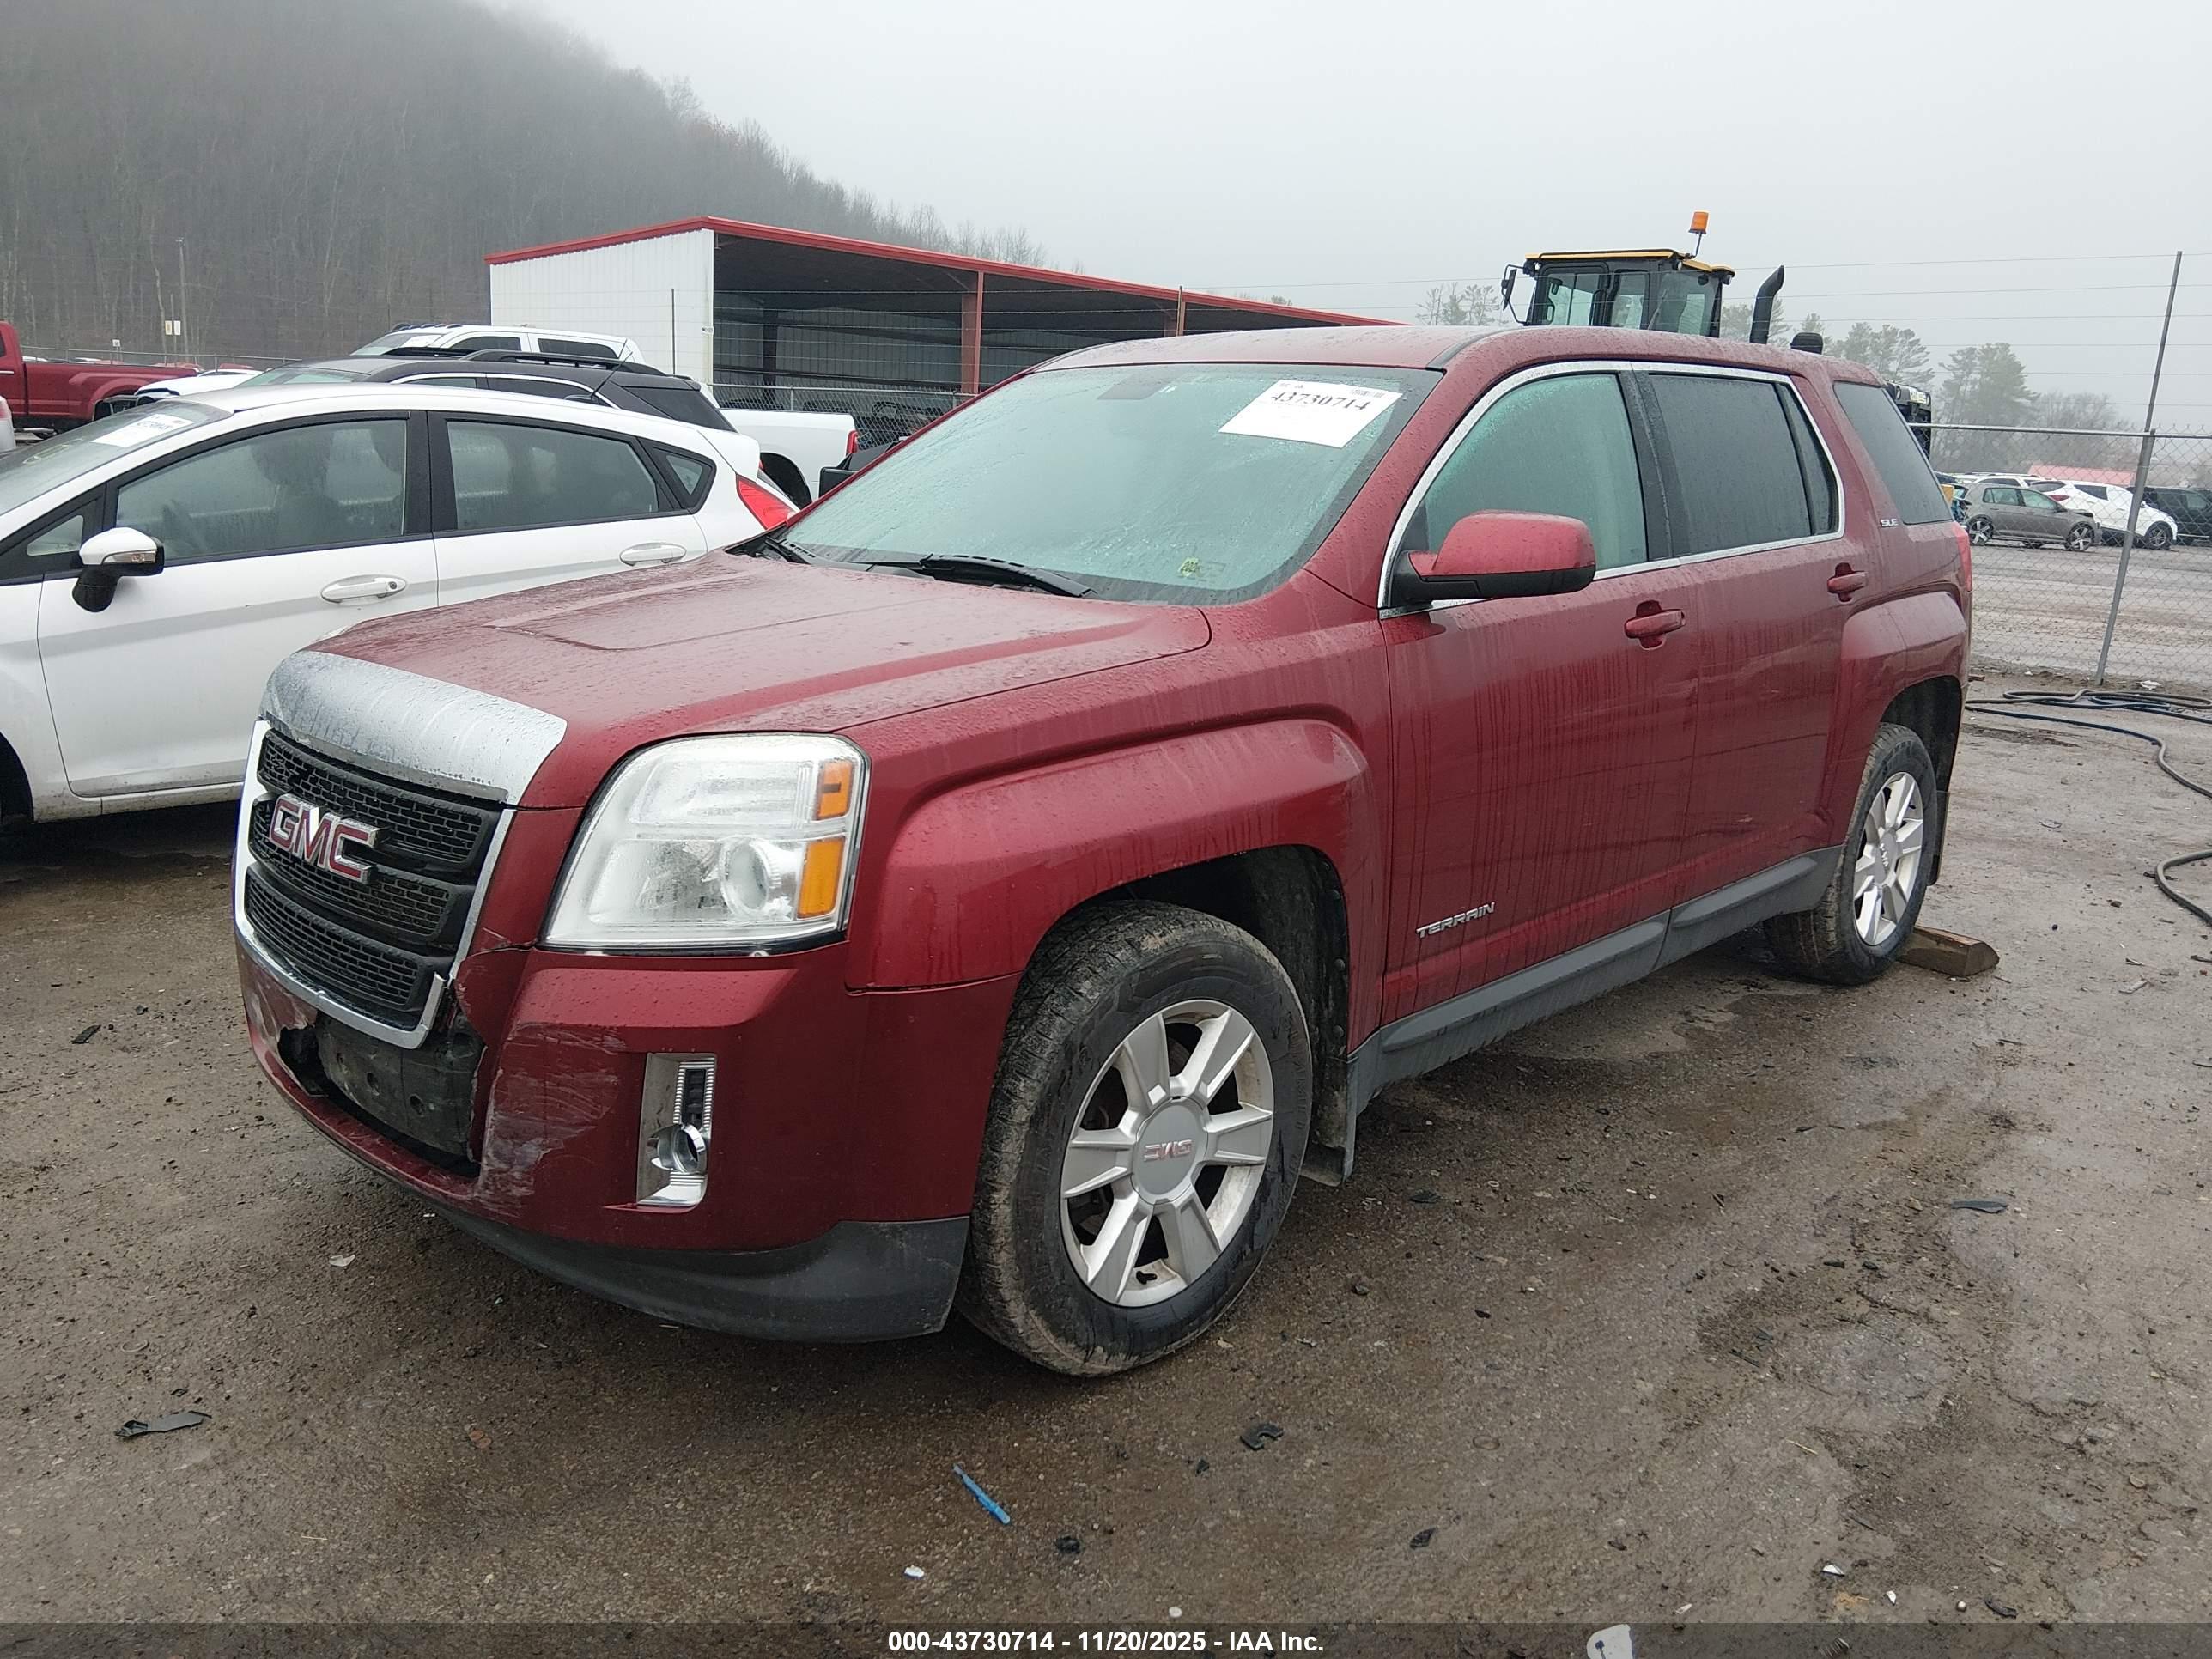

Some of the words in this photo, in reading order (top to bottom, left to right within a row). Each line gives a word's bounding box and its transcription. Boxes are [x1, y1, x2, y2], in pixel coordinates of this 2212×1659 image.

[1270, 392, 1371, 410] 43730714
[269, 793, 380, 885] GMC
[1415, 901, 1496, 939] TERRAIN
